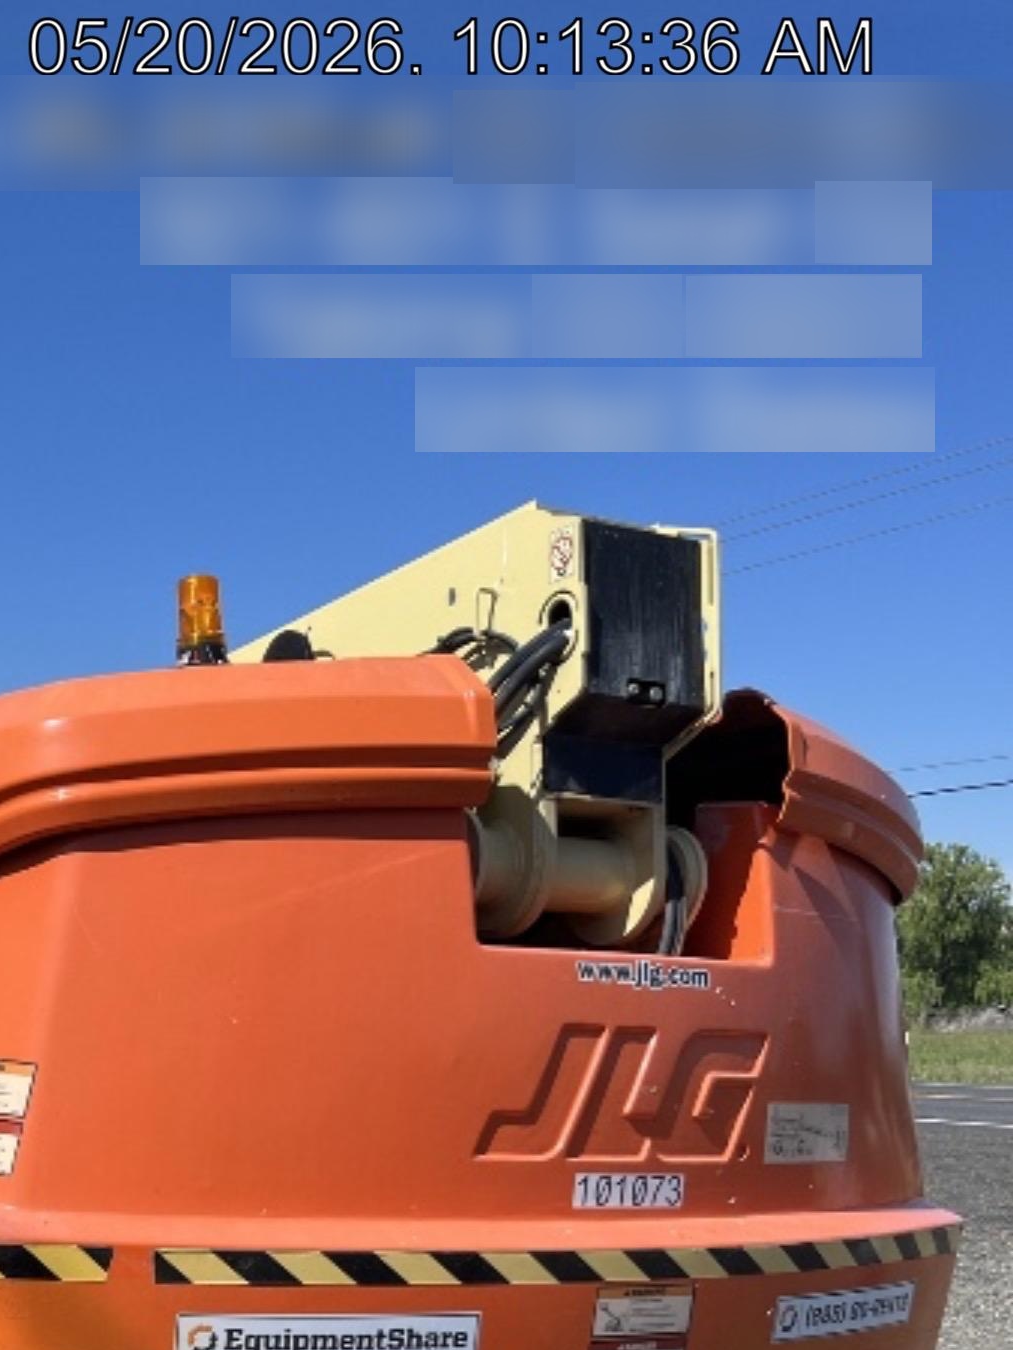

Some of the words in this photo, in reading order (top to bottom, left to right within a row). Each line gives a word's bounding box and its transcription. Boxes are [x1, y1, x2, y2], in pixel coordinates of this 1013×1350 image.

[577, 961, 709, 989] www.jlg.com
[472, 1022, 770, 1162] JLG
[577, 1174, 683, 1207] 101073
